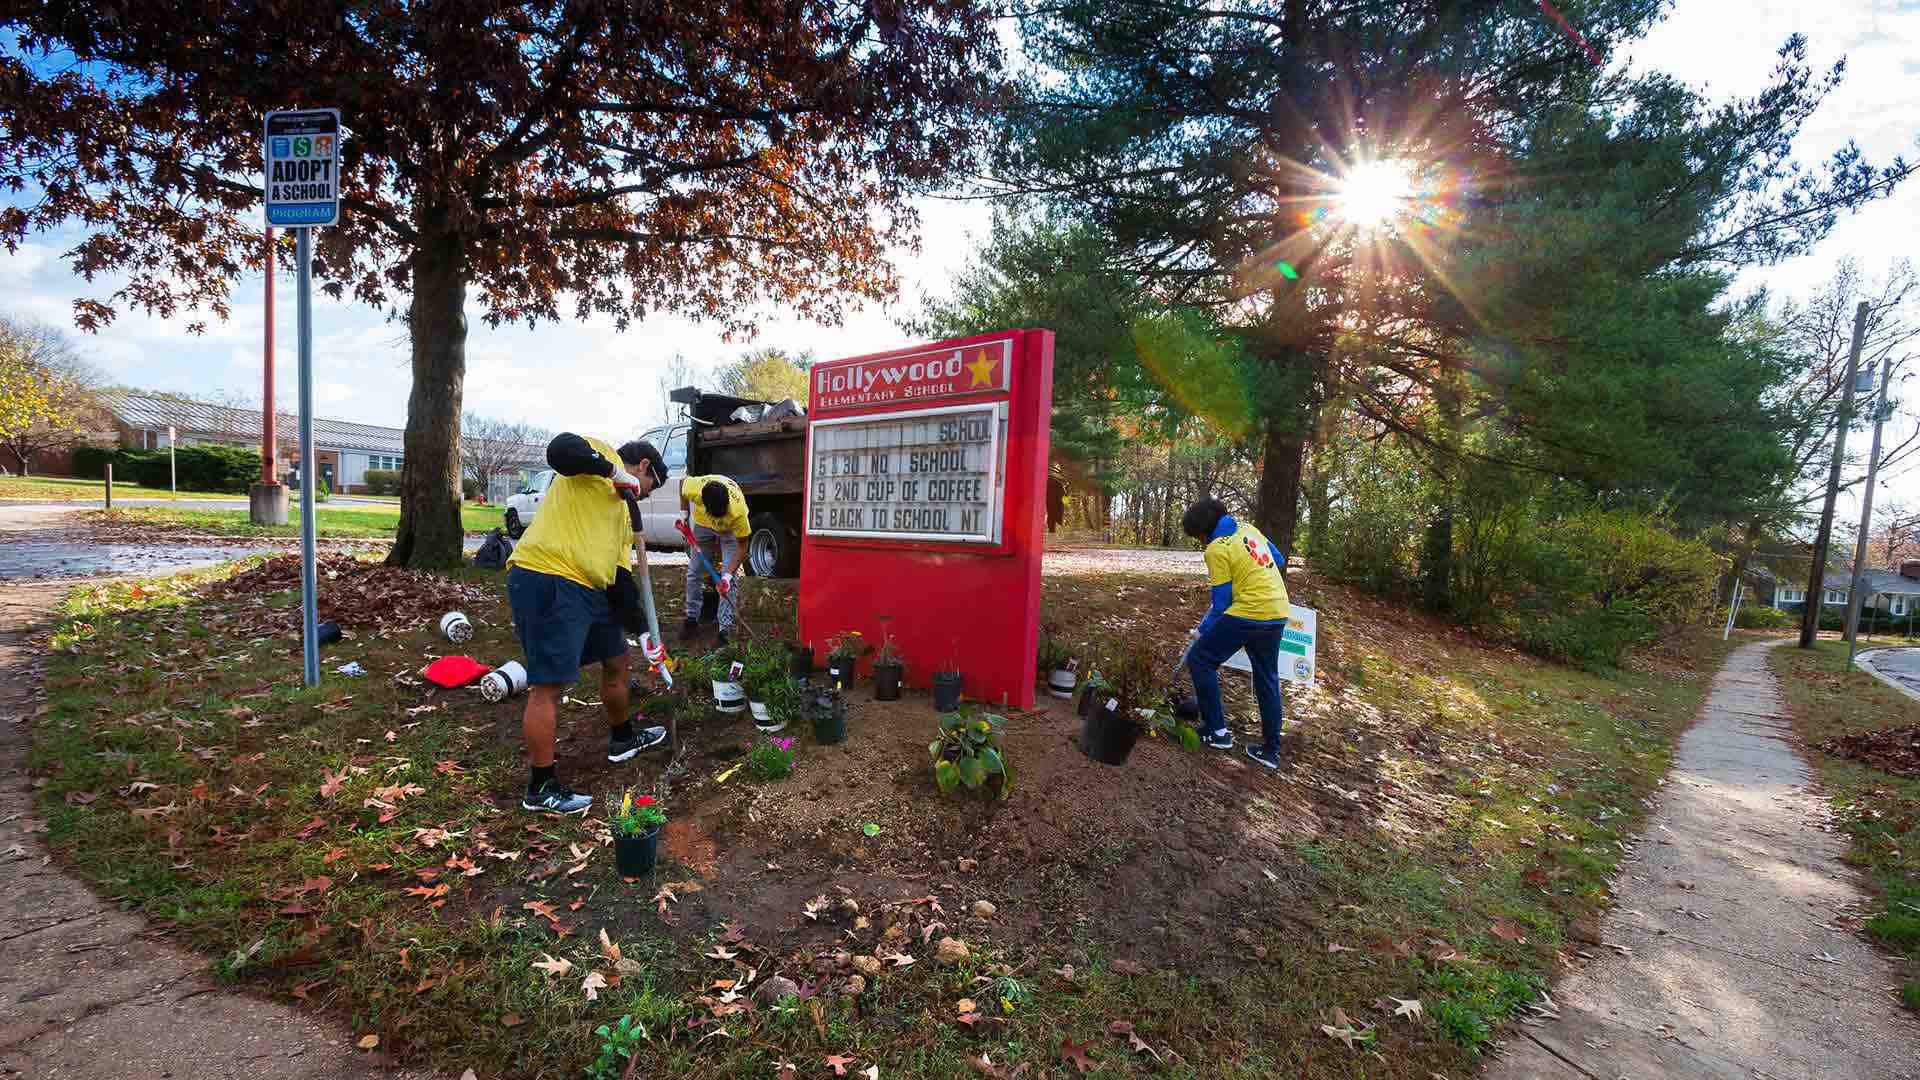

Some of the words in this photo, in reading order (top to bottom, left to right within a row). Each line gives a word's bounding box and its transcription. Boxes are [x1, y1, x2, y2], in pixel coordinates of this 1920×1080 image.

[272, 160, 331, 182] ADOPT
[272, 185, 280, 200] A
[283, 184, 331, 200] SCHOOL
[817, 351, 962, 393] Hollywood
[871, 454, 888, 473] NO
[910, 450, 966, 472] SCHOOL
[834, 480, 858, 501] 2ND
[866, 480, 894, 501] CUP
[902, 480, 918, 501] OF
[928, 479, 981, 501] COFFEE
[830, 508, 863, 528] BACK
[872, 508, 889, 529] TO
[893, 509, 949, 530] SCHOOL
[961, 509, 980, 531] NT
